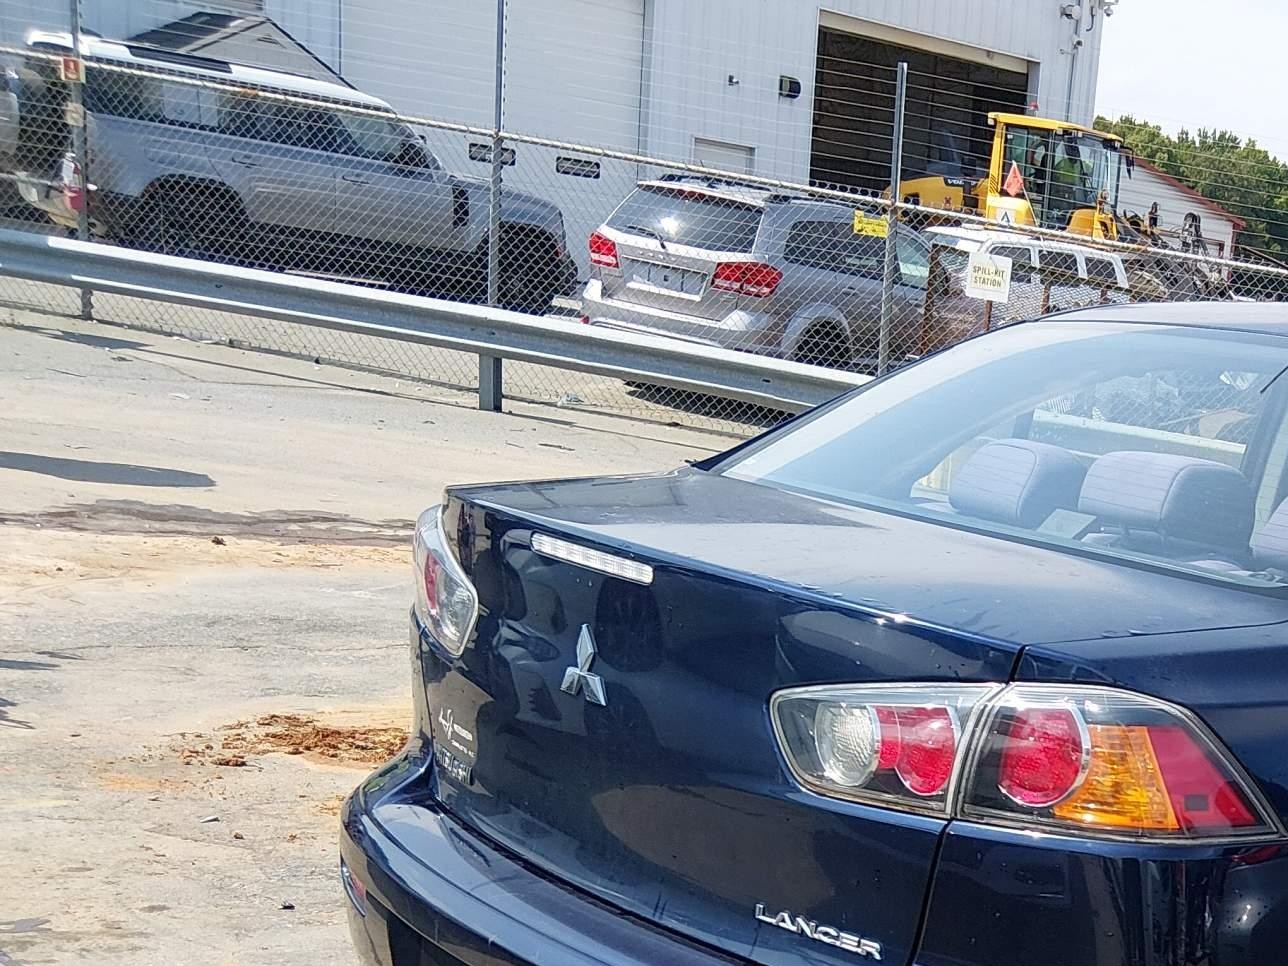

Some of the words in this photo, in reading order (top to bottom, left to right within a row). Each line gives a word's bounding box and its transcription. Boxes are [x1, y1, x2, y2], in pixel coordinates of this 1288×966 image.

[973, 266, 1005, 278] SPILL-KIT
[974, 276, 1002, 288] STATION
[755, 903, 881, 960] LANCER
